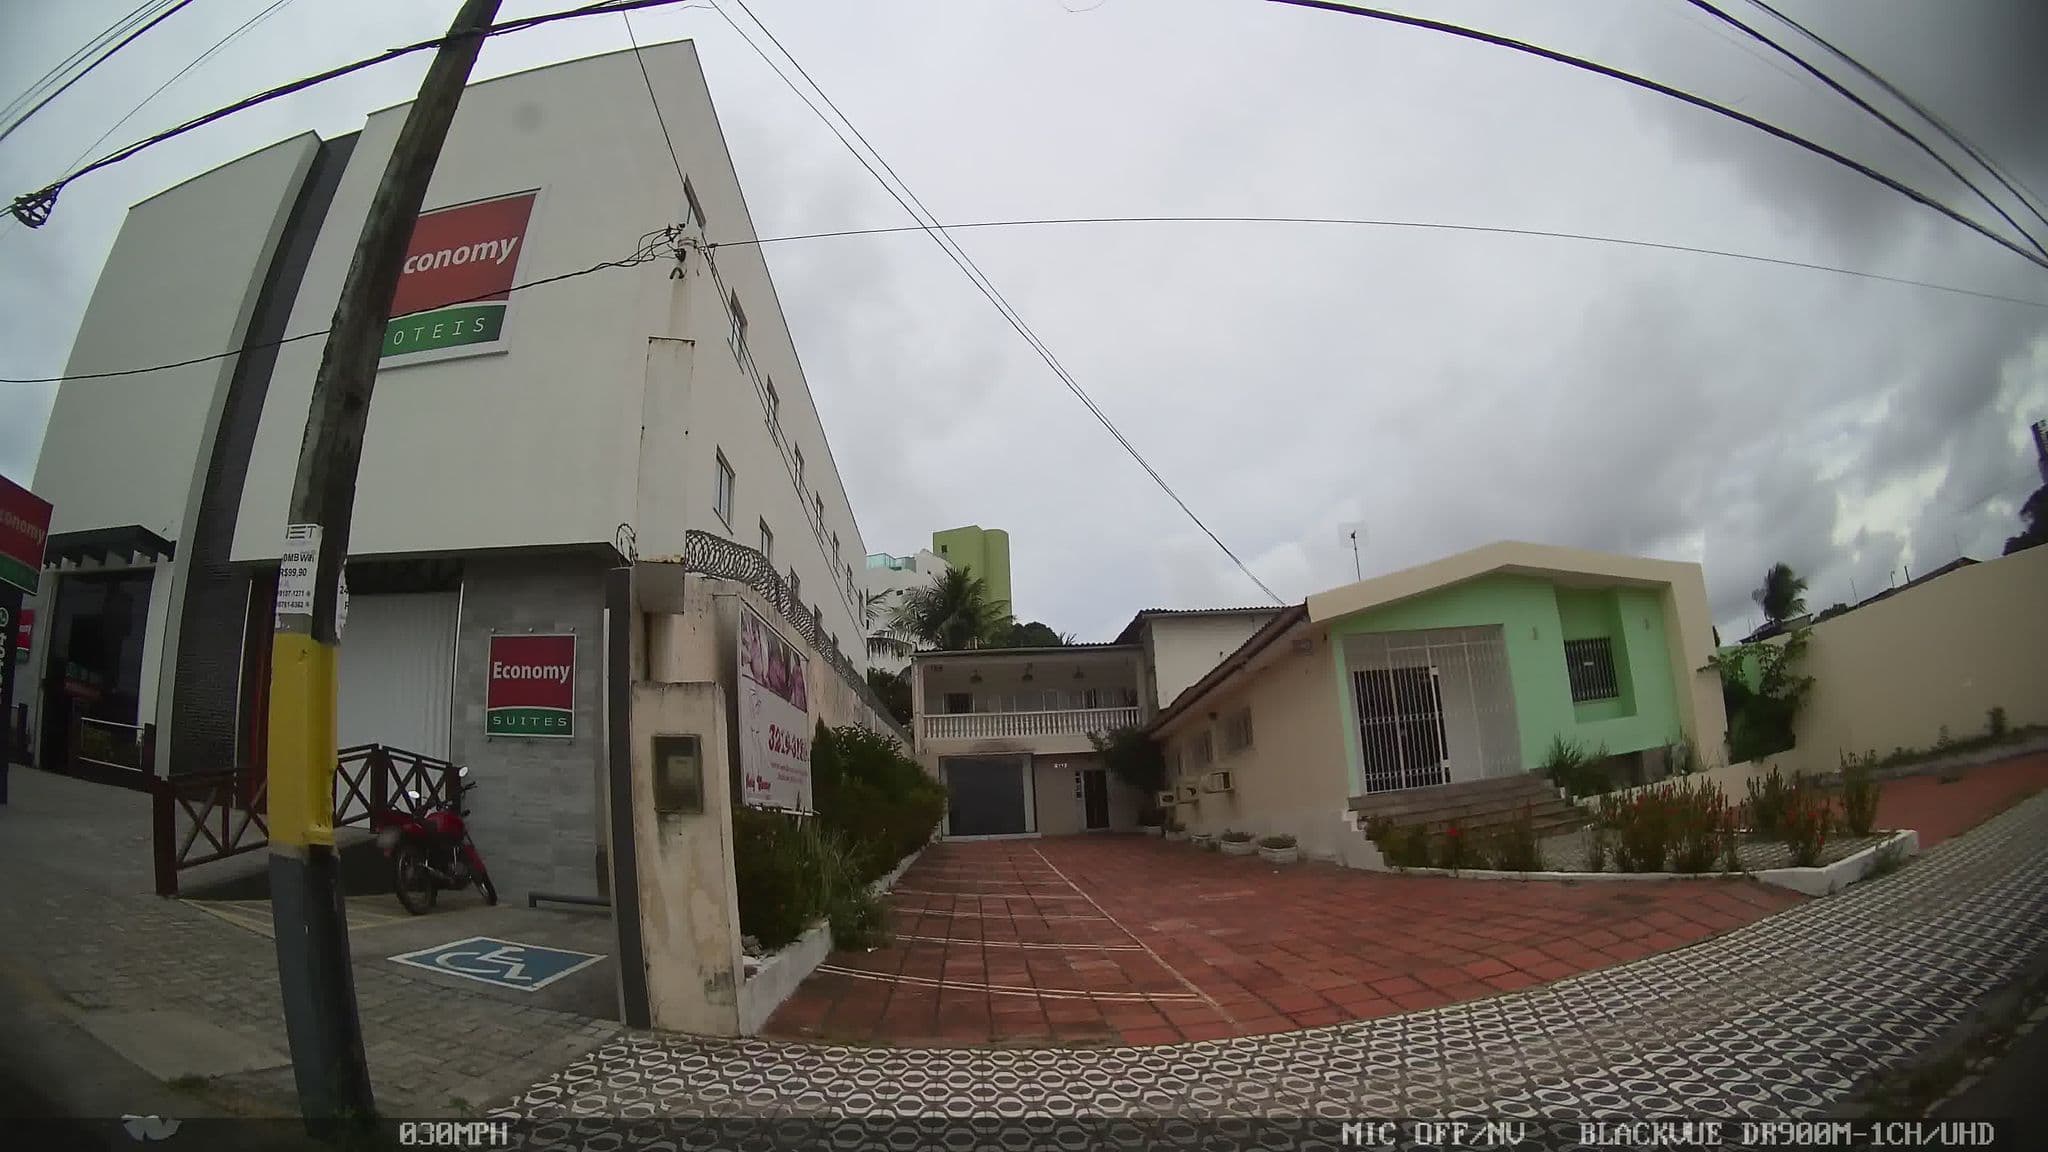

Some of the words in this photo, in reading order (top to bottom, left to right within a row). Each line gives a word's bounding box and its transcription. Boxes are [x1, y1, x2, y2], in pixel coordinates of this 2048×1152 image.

[402, 235, 518, 275] conomy
[393, 317, 486, 347] OTEIS
[493, 661, 570, 684] Economy
[493, 716, 567, 727] SUITES
